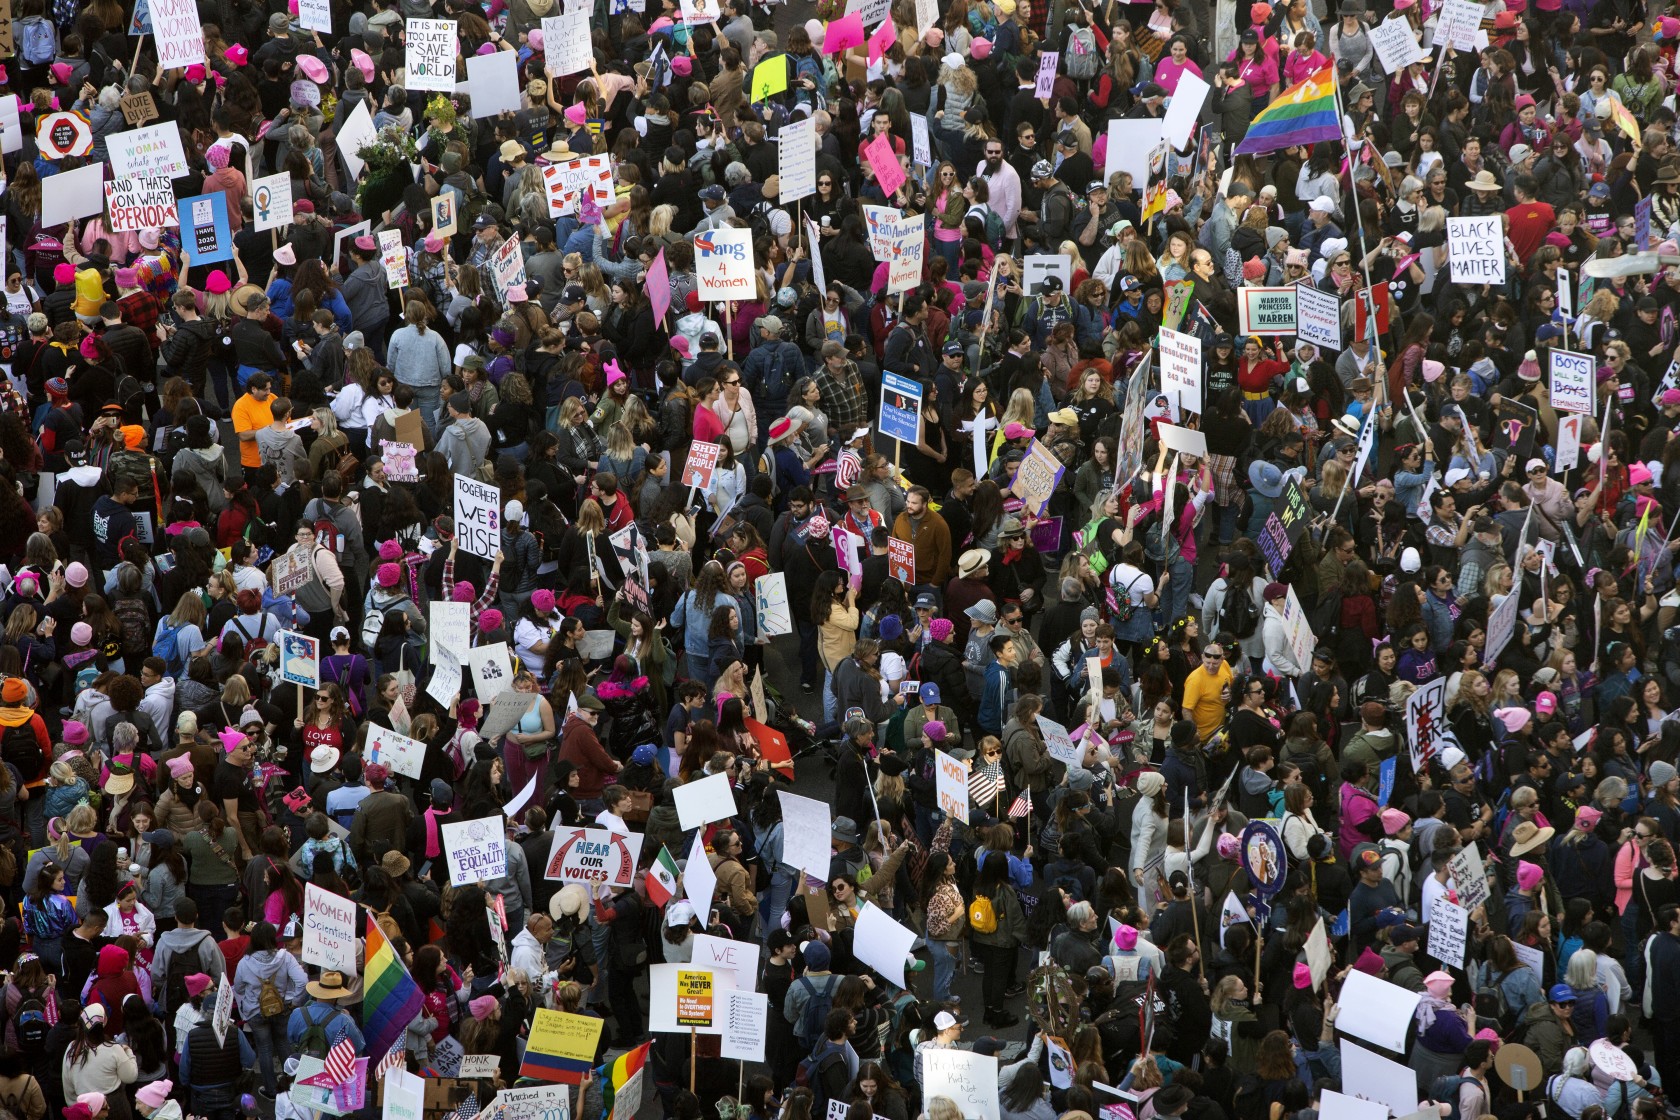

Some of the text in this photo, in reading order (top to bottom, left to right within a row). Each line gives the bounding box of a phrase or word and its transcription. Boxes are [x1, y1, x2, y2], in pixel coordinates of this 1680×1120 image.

[160, 17, 201, 38] WOMAN
[410, 22, 455, 35] IT IS NOT
[544, 18, 565, 32] NO
[407, 33, 448, 45] TOO LATE
[546, 34, 589, 51] SMILE
[416, 43, 449, 57] SAVE
[421, 57, 440, 67] THE
[410, 63, 455, 78] WORLD!
[124, 95, 150, 109] VOTE
[127, 108, 153, 122] BLUE
[125, 140, 167, 158] WOMAN
[562, 170, 590, 184] TOXIC
[110, 176, 171, 195] AND THATS
[117, 191, 174, 207] ON WHAT?
[116, 204, 166, 230] PERIOD
[884, 214, 898, 224] 2020
[200, 227, 214, 236] HAVE
[891, 222, 923, 239] Andrew
[1451, 221, 1496, 240] BLACK
[198, 235, 215, 244] 2020
[695, 231, 746, 261] Yang
[198, 243, 218, 253] VISION
[892, 240, 922, 261] Yang
[1452, 240, 1495, 256] LIVES
[718, 262, 727, 275] 4
[1452, 259, 1501, 276] MATTER
[702, 276, 748, 288] Women
[891, 270, 918, 285] Women
[1299, 289, 1336, 305] WOMEN CANNOT
[1258, 303, 1292, 311] PRINCESSES
[1316, 301, 1337, 313] ANOTHER
[1258, 313, 1294, 324] WARREN
[1161, 330, 1175, 339] NEW
[1299, 328, 1338, 346] THEM OUT!
[1306, 323, 1331, 337] VOTE
[1176, 341, 1199, 355] YEAR'S
[1172, 363, 1188, 374] LOSE
[1555, 355, 1588, 374] BOYS
[1167, 372, 1179, 382] 243
[1554, 371, 1569, 380] WILL
[1554, 380, 1589, 398] BOYS
[1552, 399, 1590, 410] FEMINISTS
[884, 405, 916, 421] Our Voices Will
[692, 443, 717, 455] SHE
[688, 456, 713, 469] PEOPLE
[456, 478, 498, 504] TOGETHER
[1287, 482, 1305, 520] THIS IS
[459, 499, 487, 524] WE
[1281, 505, 1295, 528] MY
[458, 522, 498, 558] RISE
[1265, 511, 1292, 560] RESISTING
[890, 540, 913, 553] SHE
[890, 552, 913, 567] PEOPLE
[279, 572, 308, 592] BITCH
[284, 672, 314, 686] HOPE
[308, 731, 332, 742] LOVE
[1042, 730, 1072, 748] VOTE
[1045, 739, 1077, 760] BLUE
[941, 756, 965, 785] WOMEN
[452, 842, 500, 860] HEXES FOR
[575, 841, 610, 857] HEAR
[459, 849, 506, 871] EQUALITY
[551, 850, 564, 874] WOMEN
[580, 856, 603, 867] OUR
[620, 850, 633, 878] RISING
[457, 868, 489, 882] OF THE
[565, 867, 609, 882] VOICES
[309, 888, 352, 925] WOMEN
[1435, 898, 1441, 907] I
[307, 913, 352, 942] Scientists
[318, 933, 339, 949] LEAD
[306, 946, 320, 957] the
[711, 943, 738, 965] WE
[685, 973, 706, 981] America
[690, 980, 711, 990] NEVER
[464, 1055, 489, 1065] HONK
[929, 1053, 973, 1072] Protect
[948, 1072, 970, 1084] Kids
[961, 1084, 976, 1093] Not
[504, 1091, 539, 1103] Marched
